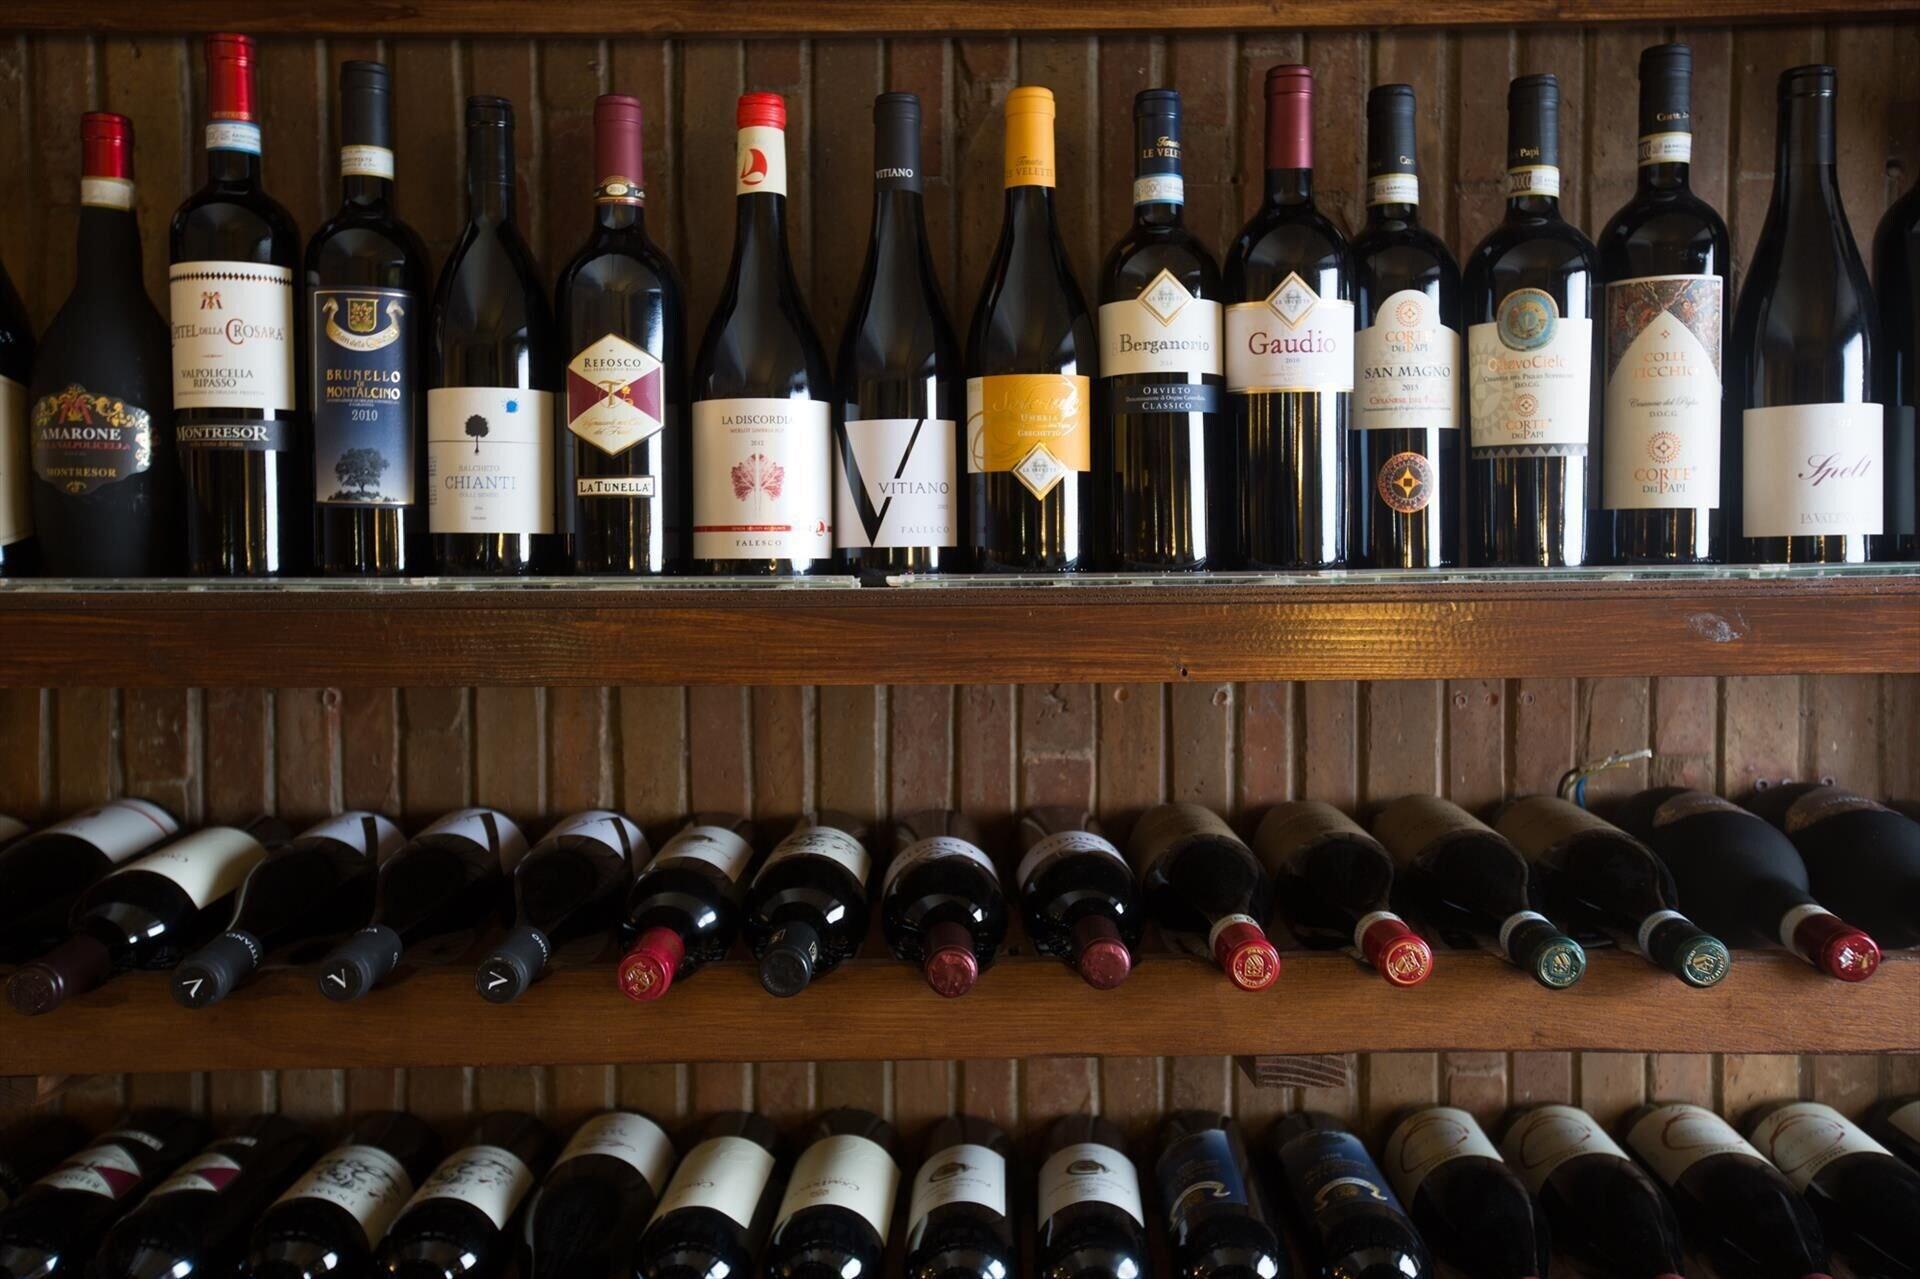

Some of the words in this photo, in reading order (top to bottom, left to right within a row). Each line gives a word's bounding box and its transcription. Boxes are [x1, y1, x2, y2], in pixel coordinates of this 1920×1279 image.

[875, 167, 914, 179] VITIANO
[225, 318, 284, 345] CROSARA
[1119, 333, 1210, 354] Berganorio
[1248, 329, 1337, 355] Gaudio
[584, 357, 642, 368] REFOSCO
[1643, 351, 1687, 362] COLLE
[181, 368, 254, 379] VALPOLICELLA
[326, 369, 401, 383] BRUNELLO
[1364, 366, 1393, 379] SAN
[1397, 366, 1452, 378] MAGNO
[193, 378, 237, 388] RIPASSO
[326, 386, 401, 401] MONTALCINO
[1142, 386, 1191, 394] ORVIETO
[1141, 402, 1192, 410] CLASSICO
[351, 410, 378, 422] 2010
[722, 416, 734, 425] LA
[40, 427, 122, 442] AMARONE
[177, 425, 270, 442] MONTRESOR
[46, 467, 118, 478] MONTRESOR
[1634, 467, 1692, 482] CORTE
[444, 475, 518, 490] CHIANTI
[878, 482, 950, 495] VITIANO
[735, 539, 783, 547] FALESCO
